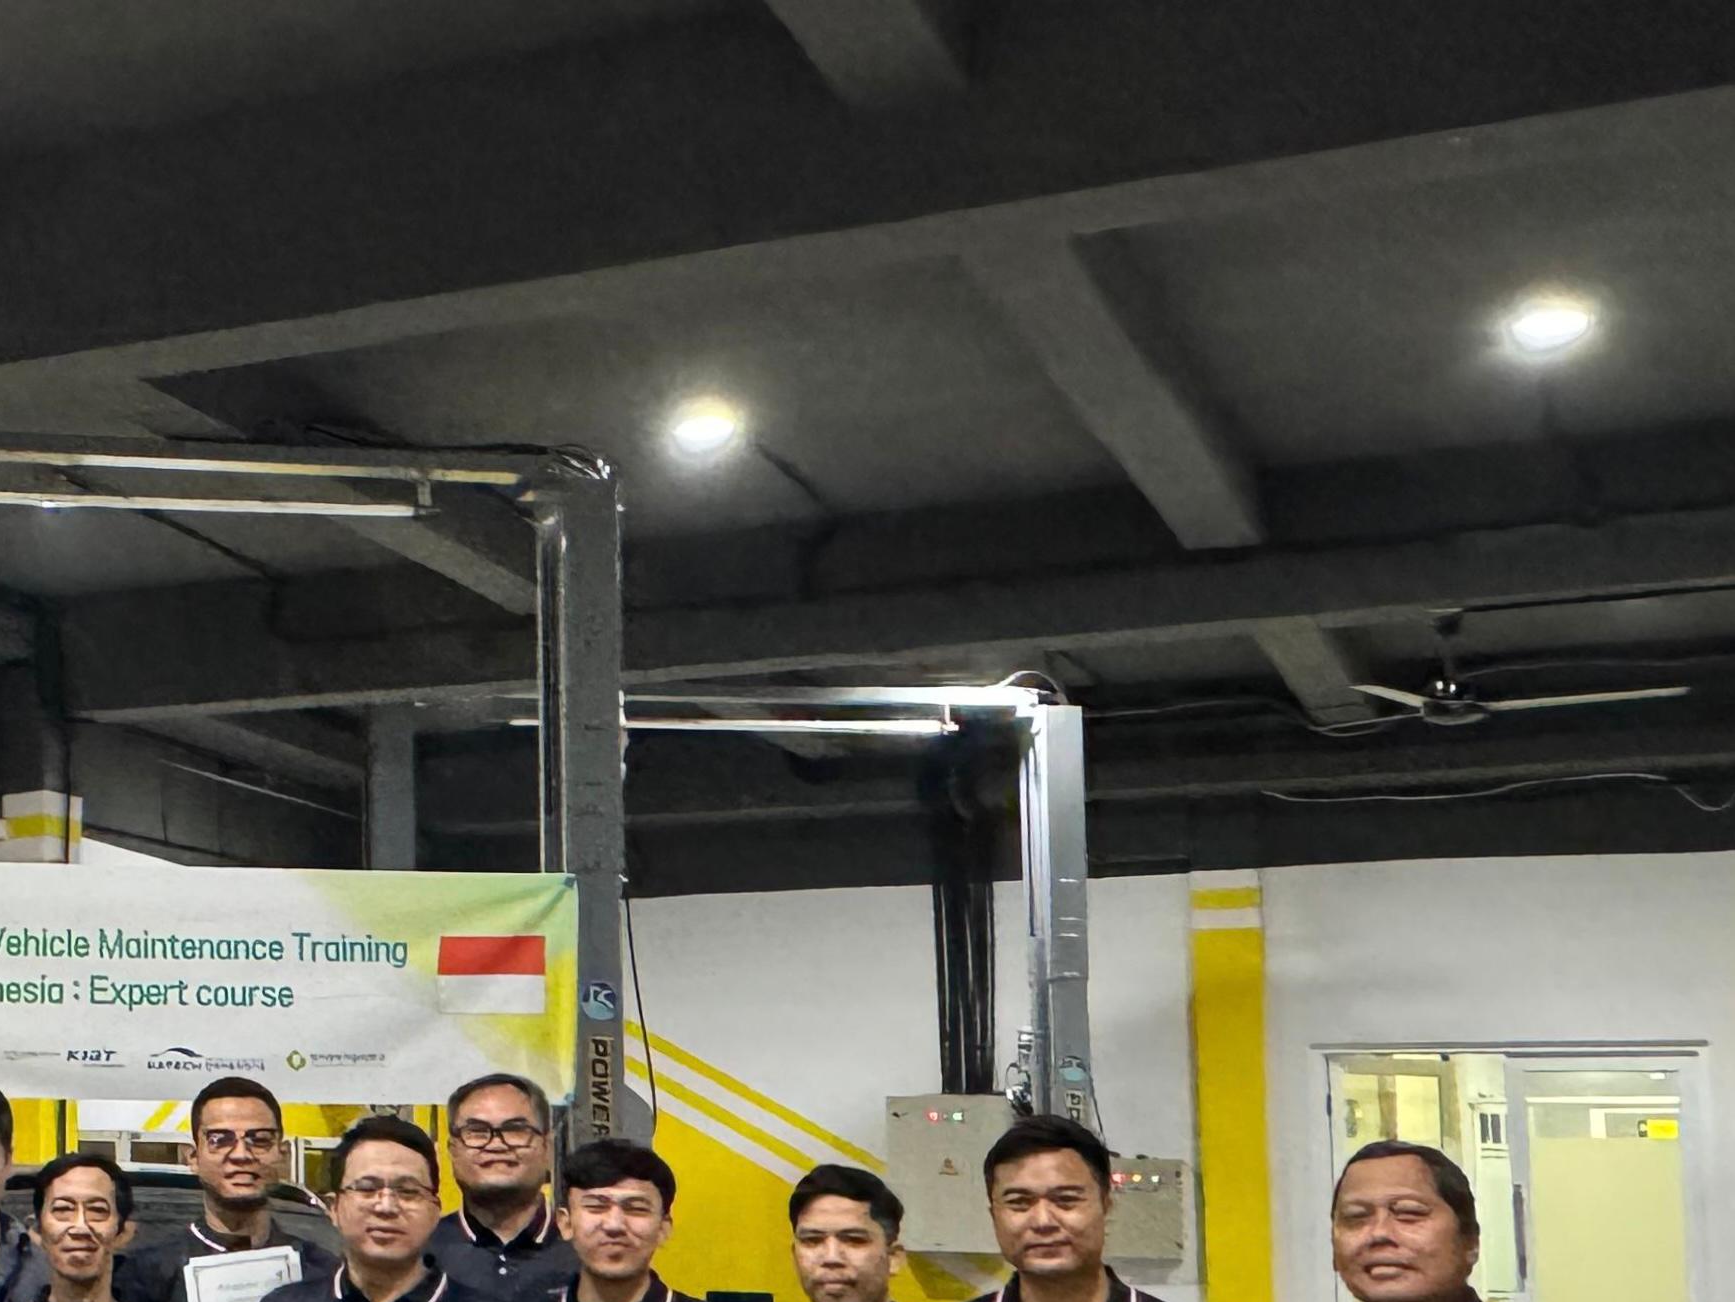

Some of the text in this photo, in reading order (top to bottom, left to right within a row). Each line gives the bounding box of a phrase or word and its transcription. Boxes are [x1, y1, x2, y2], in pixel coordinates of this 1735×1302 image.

[98, 928, 284, 961] Maintenance
[291, 932, 408, 968] Training
[89, 974, 189, 1012] Expert
[195, 982, 295, 1008] course
